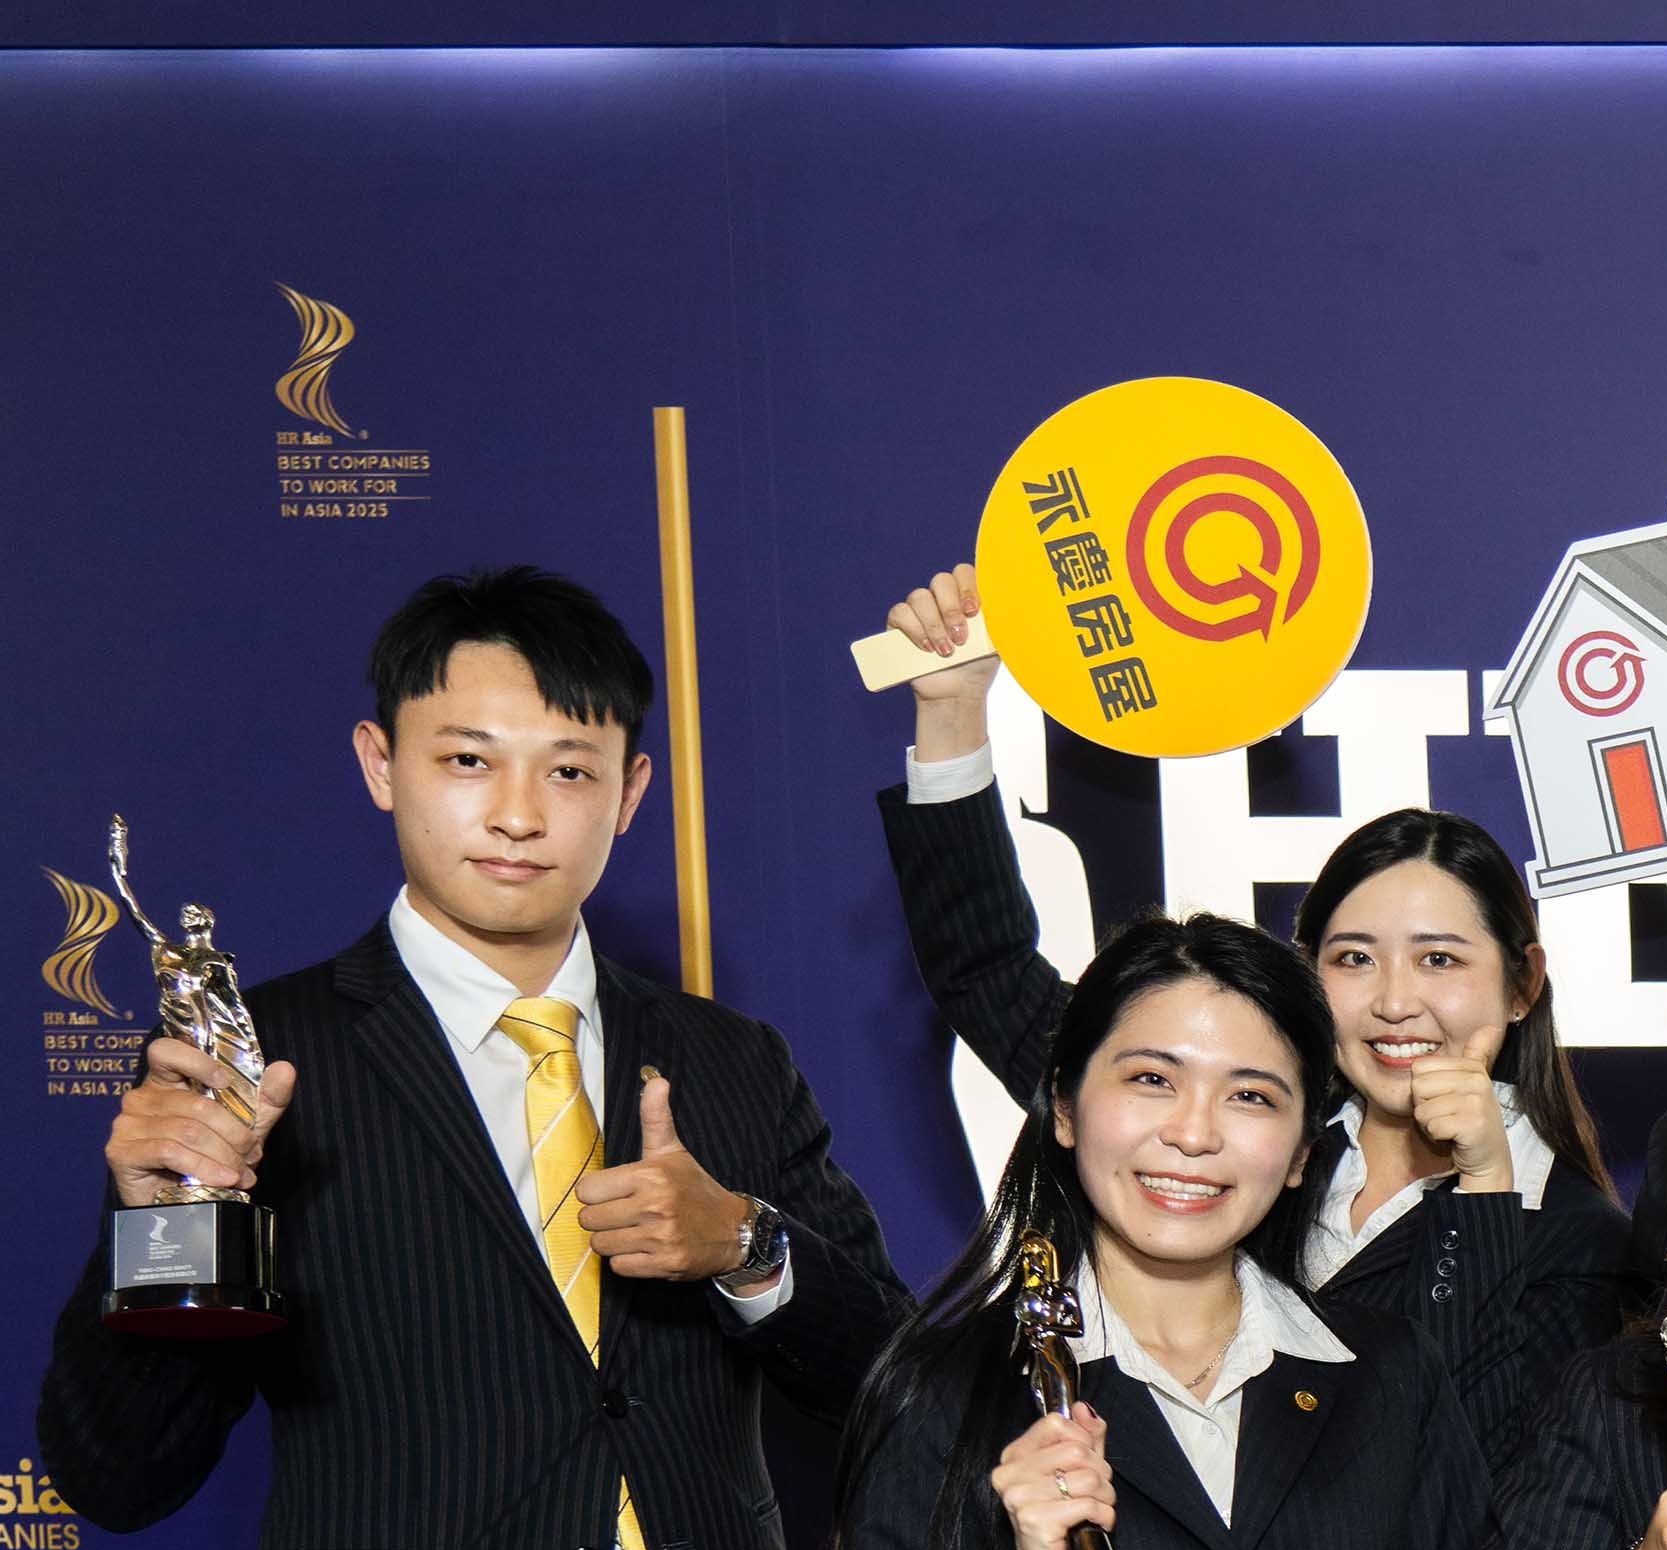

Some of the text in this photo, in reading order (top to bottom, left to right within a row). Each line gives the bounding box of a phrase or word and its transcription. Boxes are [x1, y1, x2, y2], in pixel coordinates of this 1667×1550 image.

[302, 431, 333, 445] Asia
[277, 455, 431, 470] BEST COMPANIES
[280, 479, 397, 494] TO WORK FOR
[281, 503, 388, 518] IN ASIA 2025
[1021, 466, 1158, 723] 永慶房屋
[68, 1011, 98, 1025] Asia
[44, 1035, 88, 1049] BEST
[48, 1059, 70, 1073] TO
[75, 1059, 124, 1073] WORK
[48, 1082, 65, 1096] IN
[70, 1082, 107, 1096] ASIA
